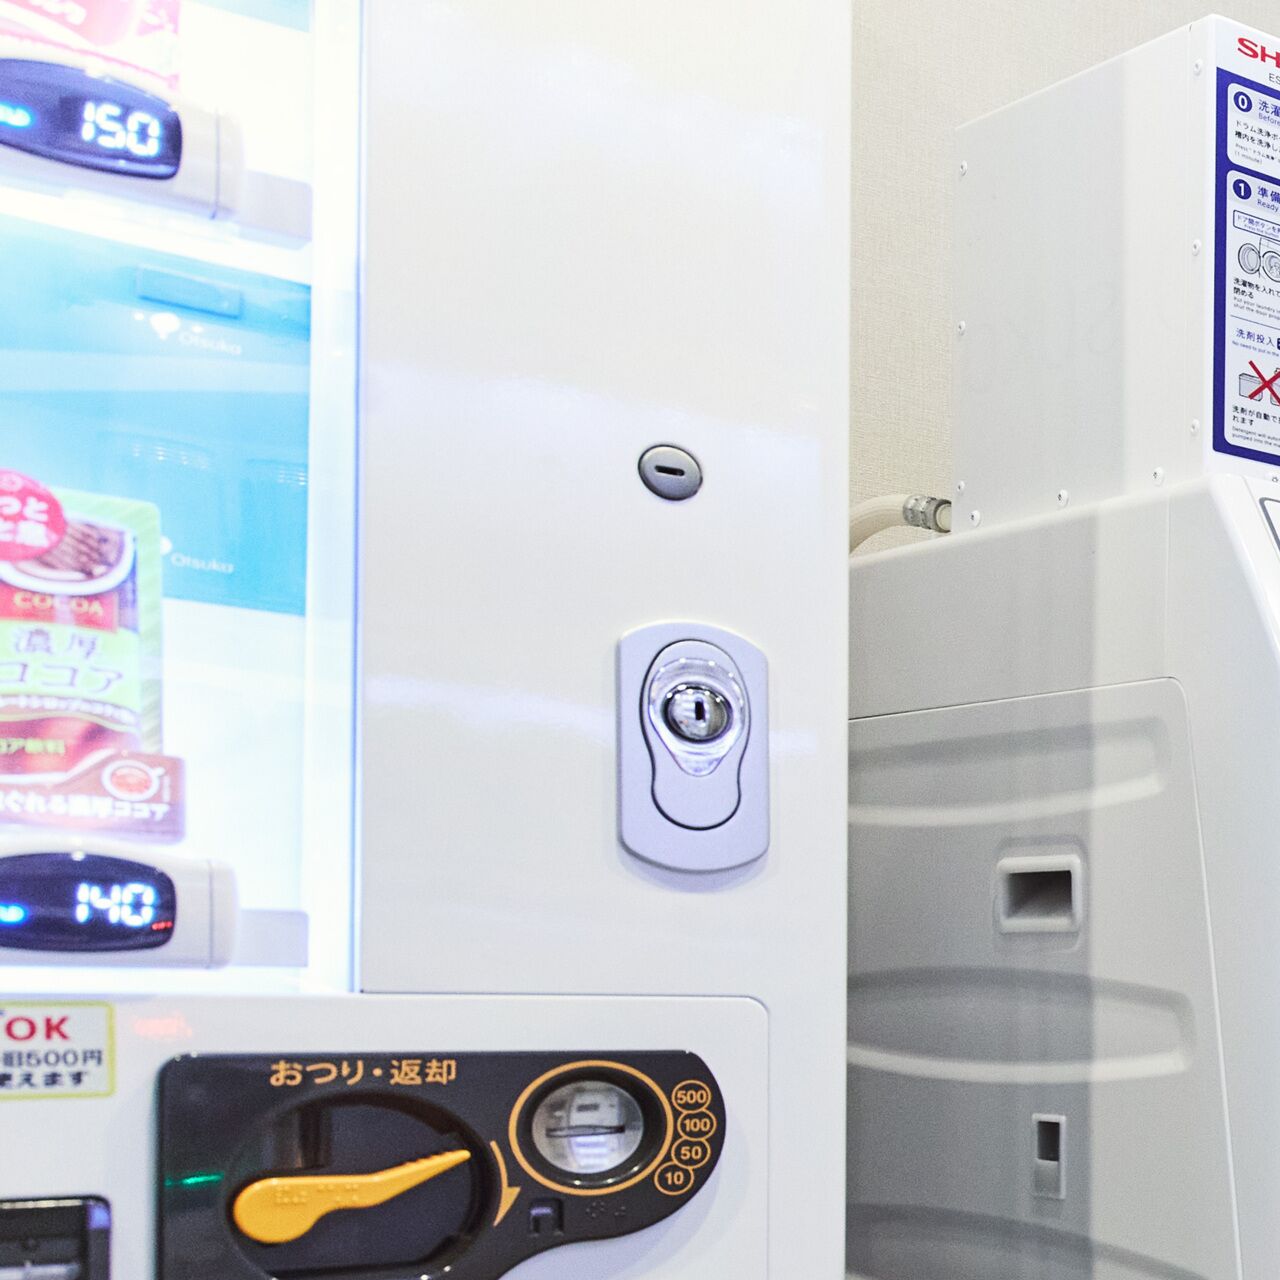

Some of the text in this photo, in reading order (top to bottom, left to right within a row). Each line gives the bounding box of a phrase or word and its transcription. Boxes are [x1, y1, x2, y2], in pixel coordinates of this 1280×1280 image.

[81, 101, 161, 157] 150
[1257, 185, 1280, 204] 準備
[1257, 197, 1279, 213] Ready
[171, 552, 234, 573] Otsuka
[76, 882, 156, 927] 140
[5, 1016, 70, 1041] OK
[268, 1059, 458, 1087] おつり・返却
[676, 1090, 708, 1104] 500
[683, 1118, 711, 1132] 100
[680, 1146, 703, 1159] 50
[665, 1171, 684, 1185] 10
